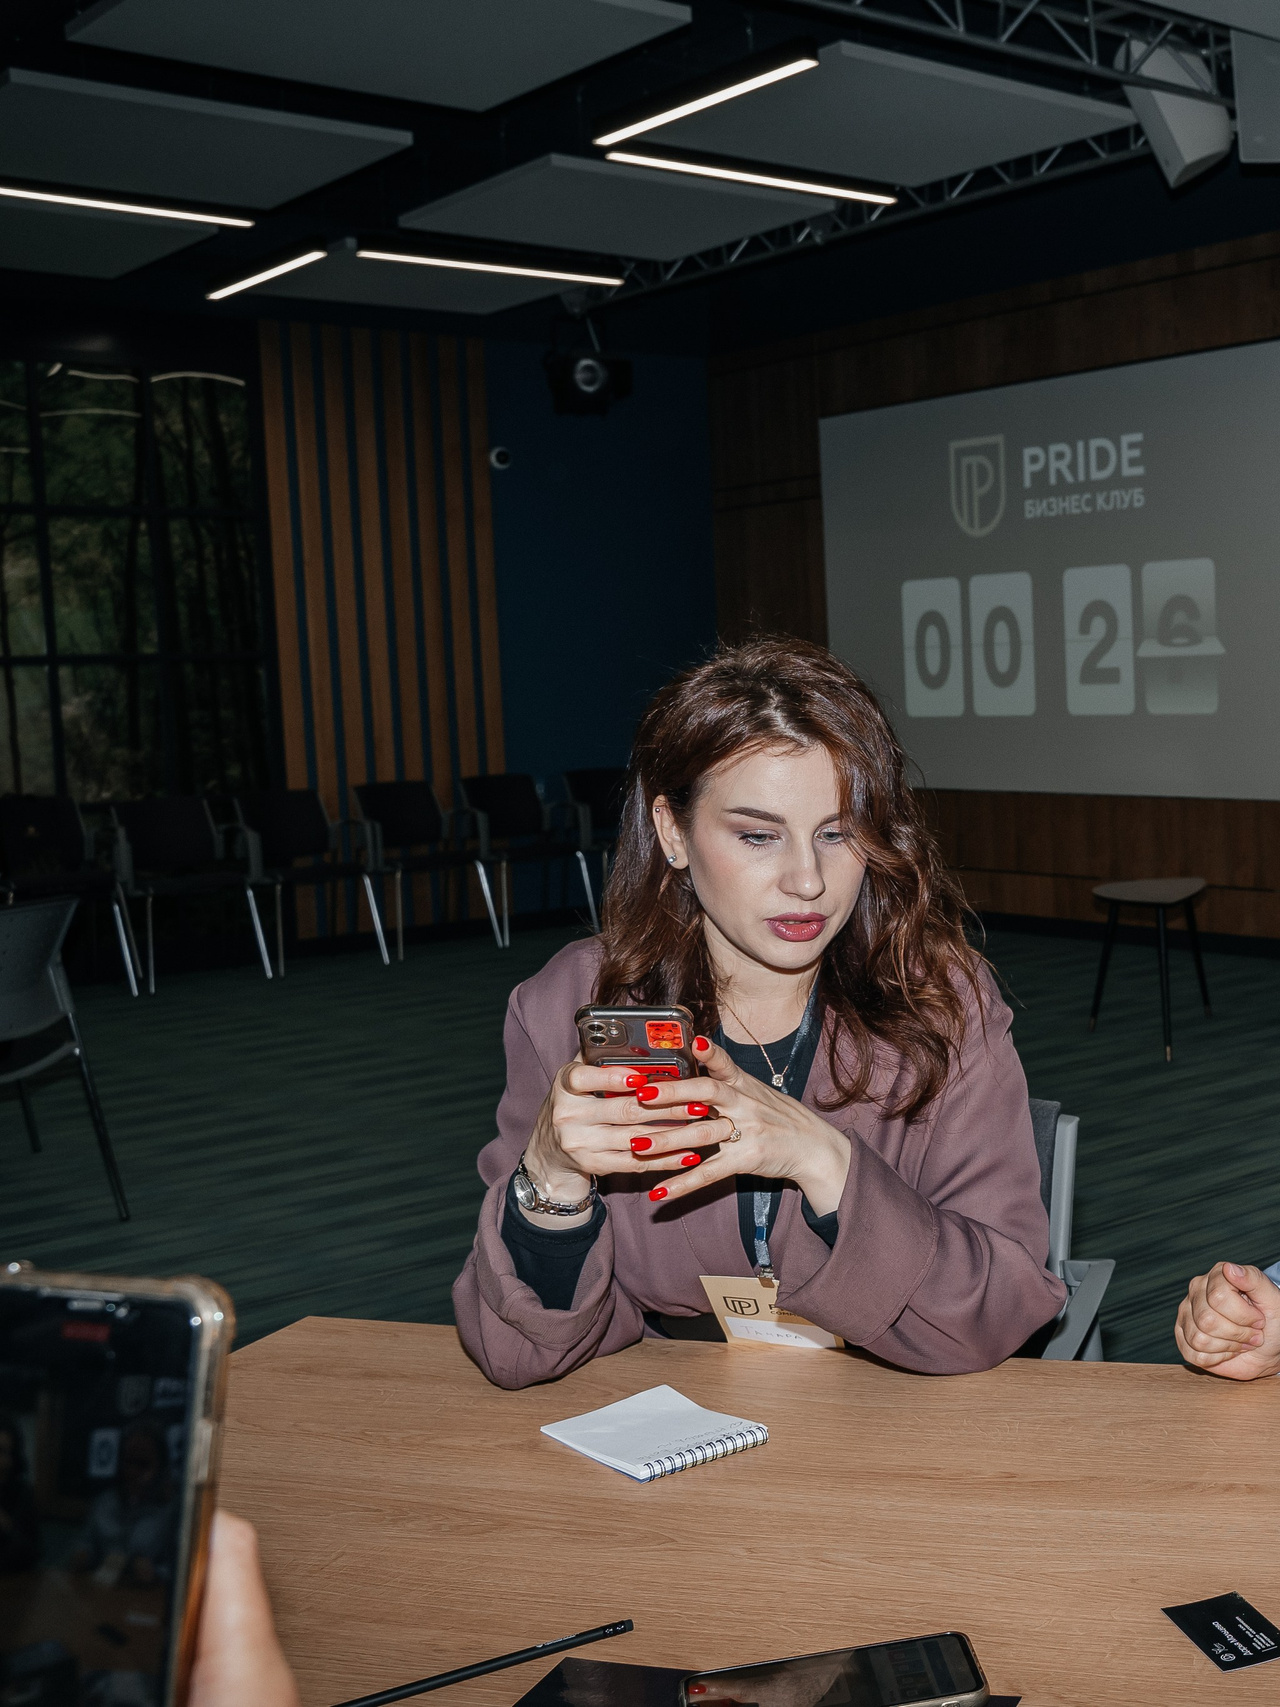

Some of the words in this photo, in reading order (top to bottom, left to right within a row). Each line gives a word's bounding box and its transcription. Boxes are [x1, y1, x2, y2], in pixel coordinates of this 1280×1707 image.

[1023, 432, 1145, 489] PRIDE
[1024, 492, 1092, 519] БИЗНЕС
[1096, 487, 1145, 511] КЛУБ
